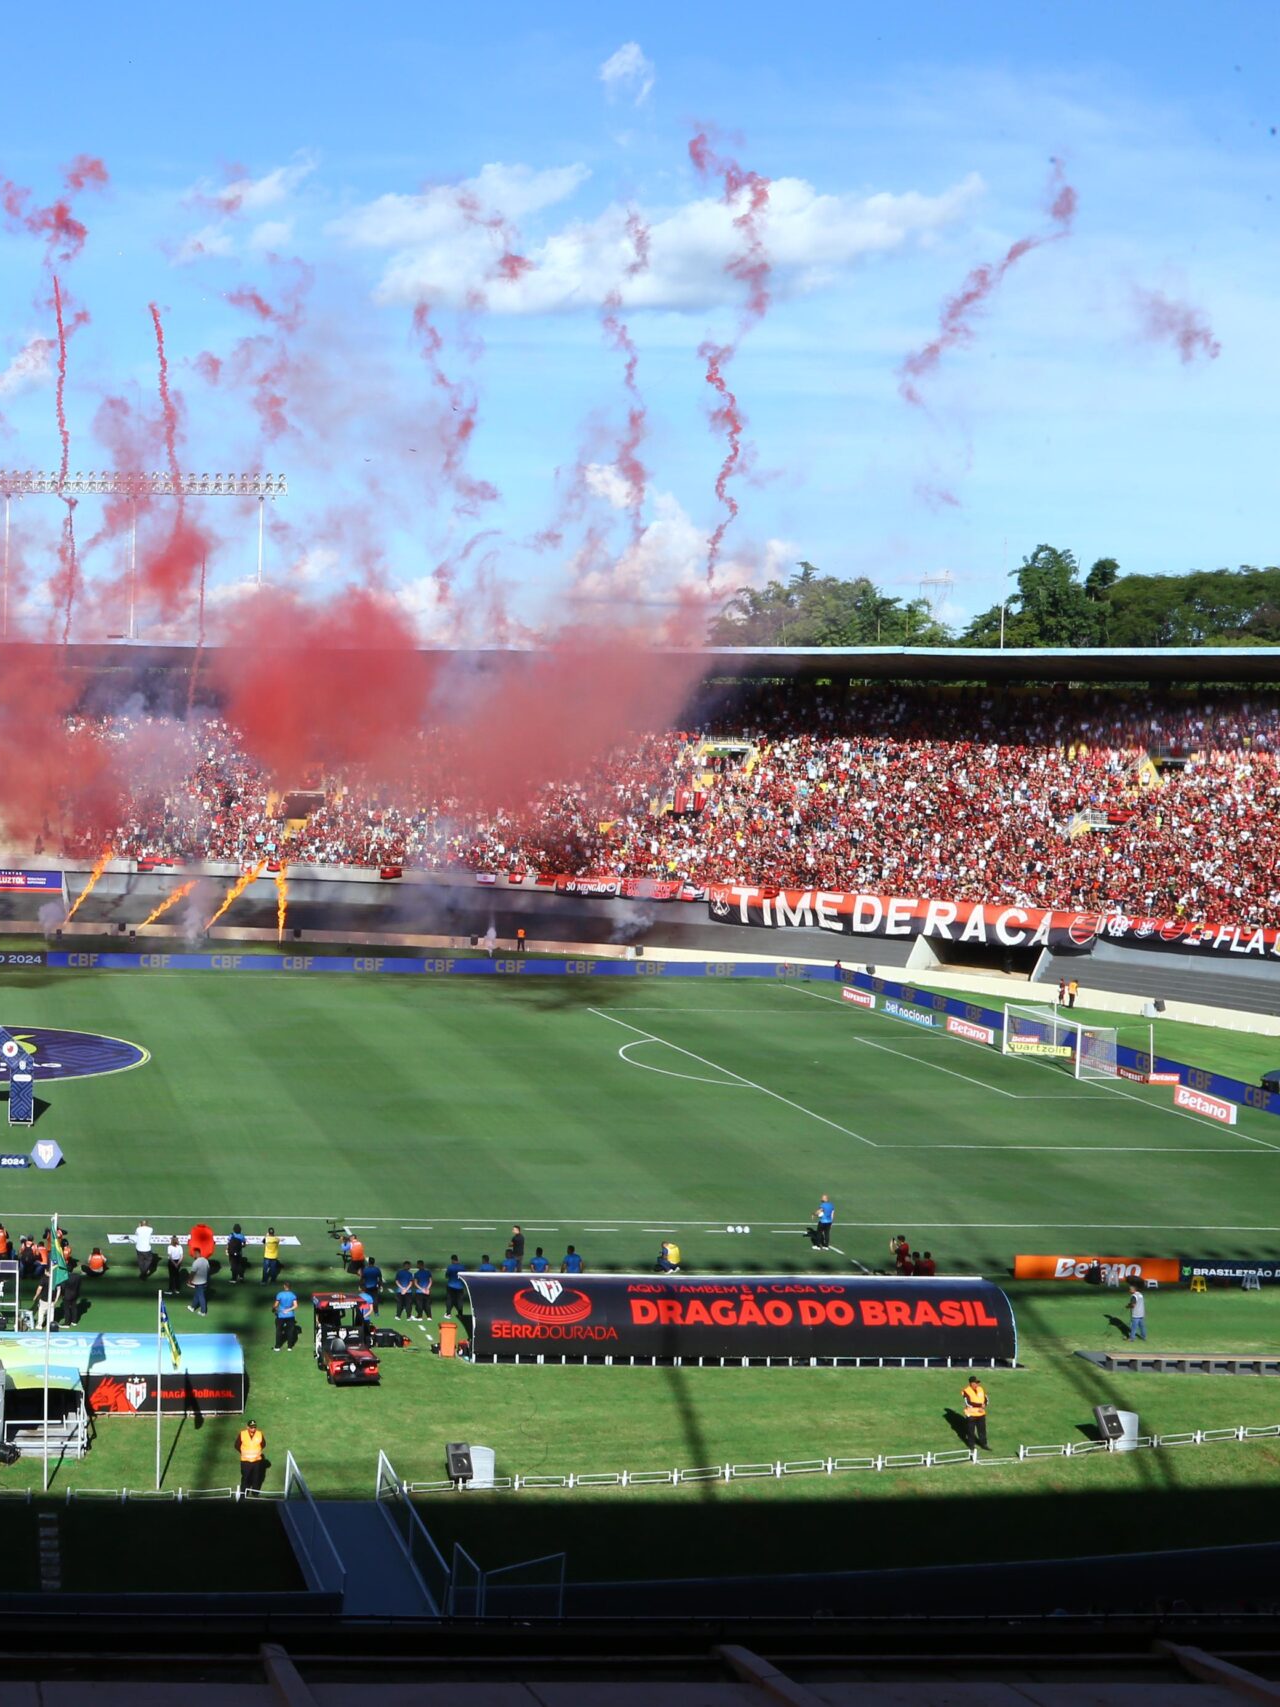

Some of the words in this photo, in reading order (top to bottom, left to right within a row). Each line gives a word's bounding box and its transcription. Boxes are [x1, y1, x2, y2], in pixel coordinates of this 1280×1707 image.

[730, 886, 844, 931] TIME
[852, 897, 918, 935] DE
[1212, 925, 1265, 955] FLA
[8, 955, 42, 964] 2024
[68, 954, 98, 967] CBF
[139, 954, 169, 968] CBF
[211, 955, 242, 968] CBF
[282, 956, 313, 970] CBF
[353, 957, 384, 971] CBF
[424, 959, 455, 972] CBF
[495, 959, 525, 973] CBF
[565, 960, 595, 974] CBF
[635, 960, 666, 975] CBF
[705, 963, 735, 976] CBF
[949, 1021, 987, 1040] Betano
[1187, 1069, 1213, 1090] CBF
[1178, 1090, 1227, 1118] Betano
[1245, 1086, 1271, 1109] CBF
[1055, 1258, 1142, 1278] Beano
[1193, 1267, 1273, 1277] BRASILEIRÃO
[628, 1285, 666, 1294] AQUI
[757, 1285, 769, 1294] A
[772, 1285, 816, 1294] CASA
[820, 1285, 845, 1294] DO
[630, 1295, 793, 1327] DRAGÃO
[799, 1300, 854, 1327] DO
[860, 1300, 998, 1328] BRASIL
